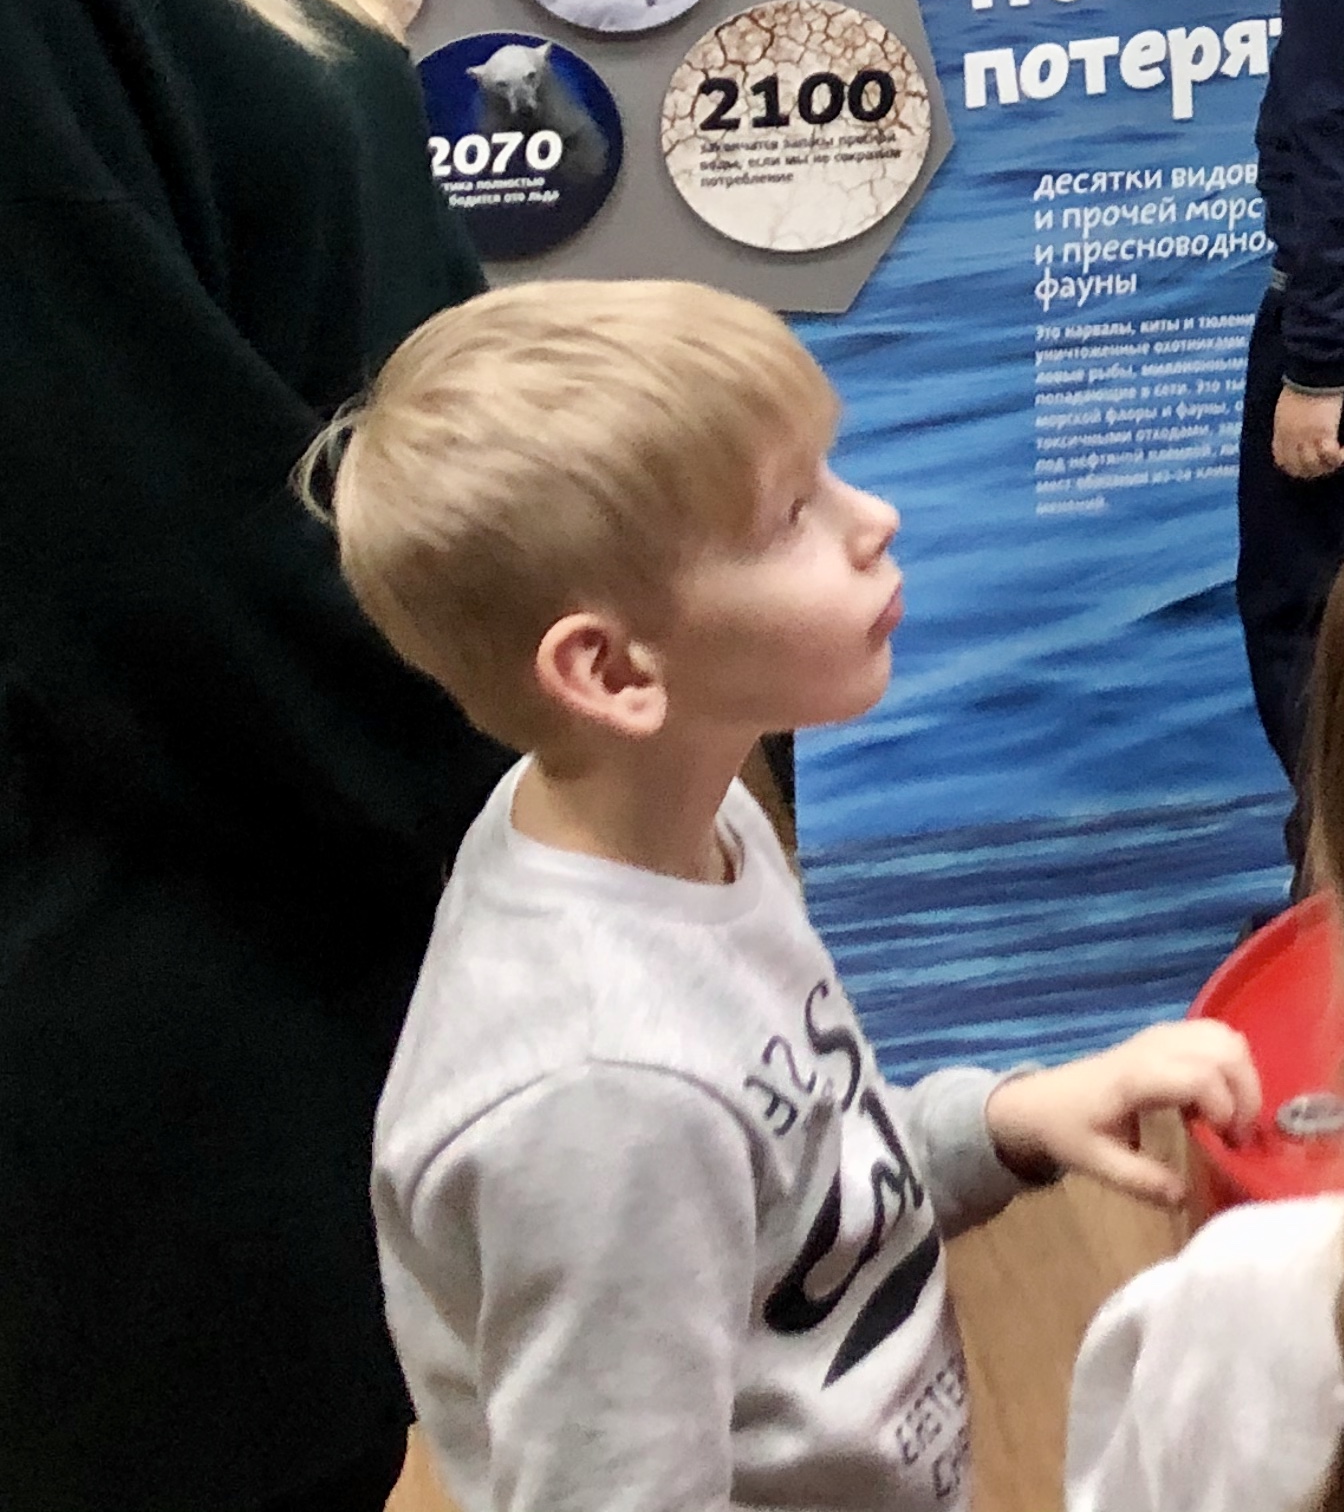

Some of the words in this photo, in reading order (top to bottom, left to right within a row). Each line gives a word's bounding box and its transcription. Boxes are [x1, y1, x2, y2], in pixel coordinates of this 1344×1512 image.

[963, 16, 1282, 122] потеря
[699, 68, 898, 132] 2100
[428, 129, 564, 177] 2070
[1033, 168, 1163, 201] десятки
[1171, 163, 1259, 189] видов
[1034, 208, 1053, 230] и
[1062, 197, 1178, 239] прочей
[1185, 196, 1263, 231] морс
[1034, 267, 1138, 312] фауны
